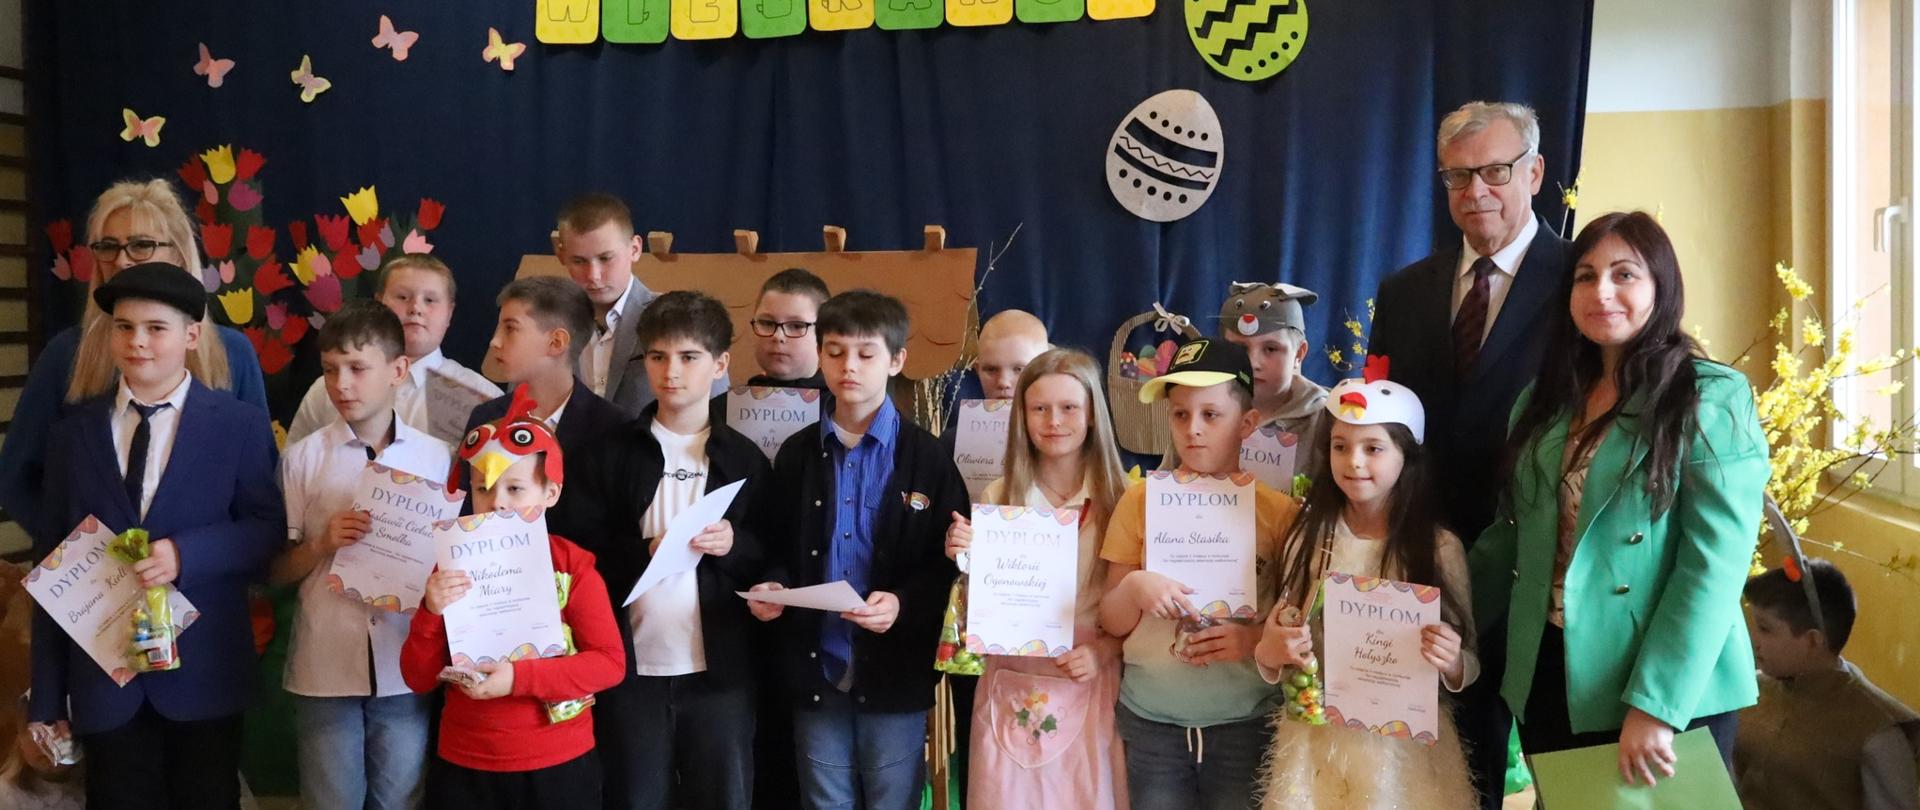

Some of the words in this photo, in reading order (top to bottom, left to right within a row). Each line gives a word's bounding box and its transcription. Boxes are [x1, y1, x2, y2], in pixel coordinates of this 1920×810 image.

[739, 407, 806, 422] DYPLOM
[970, 420, 1009, 432] DYPL
[371, 487, 443, 520] DYPLOM
[1160, 492, 1238, 506] DYPLOM
[986, 529, 1061, 547] DYPLOM
[1153, 531, 1185, 544] Alana
[1188, 531, 1229, 544] Stasika
[450, 533, 531, 560] DYPLOM
[995, 557, 1041, 570] Wiktorii
[470, 565, 522, 581] Nikodema
[1340, 600, 1421, 626] DYPLOM
[1365, 632, 1392, 650] Kingi
